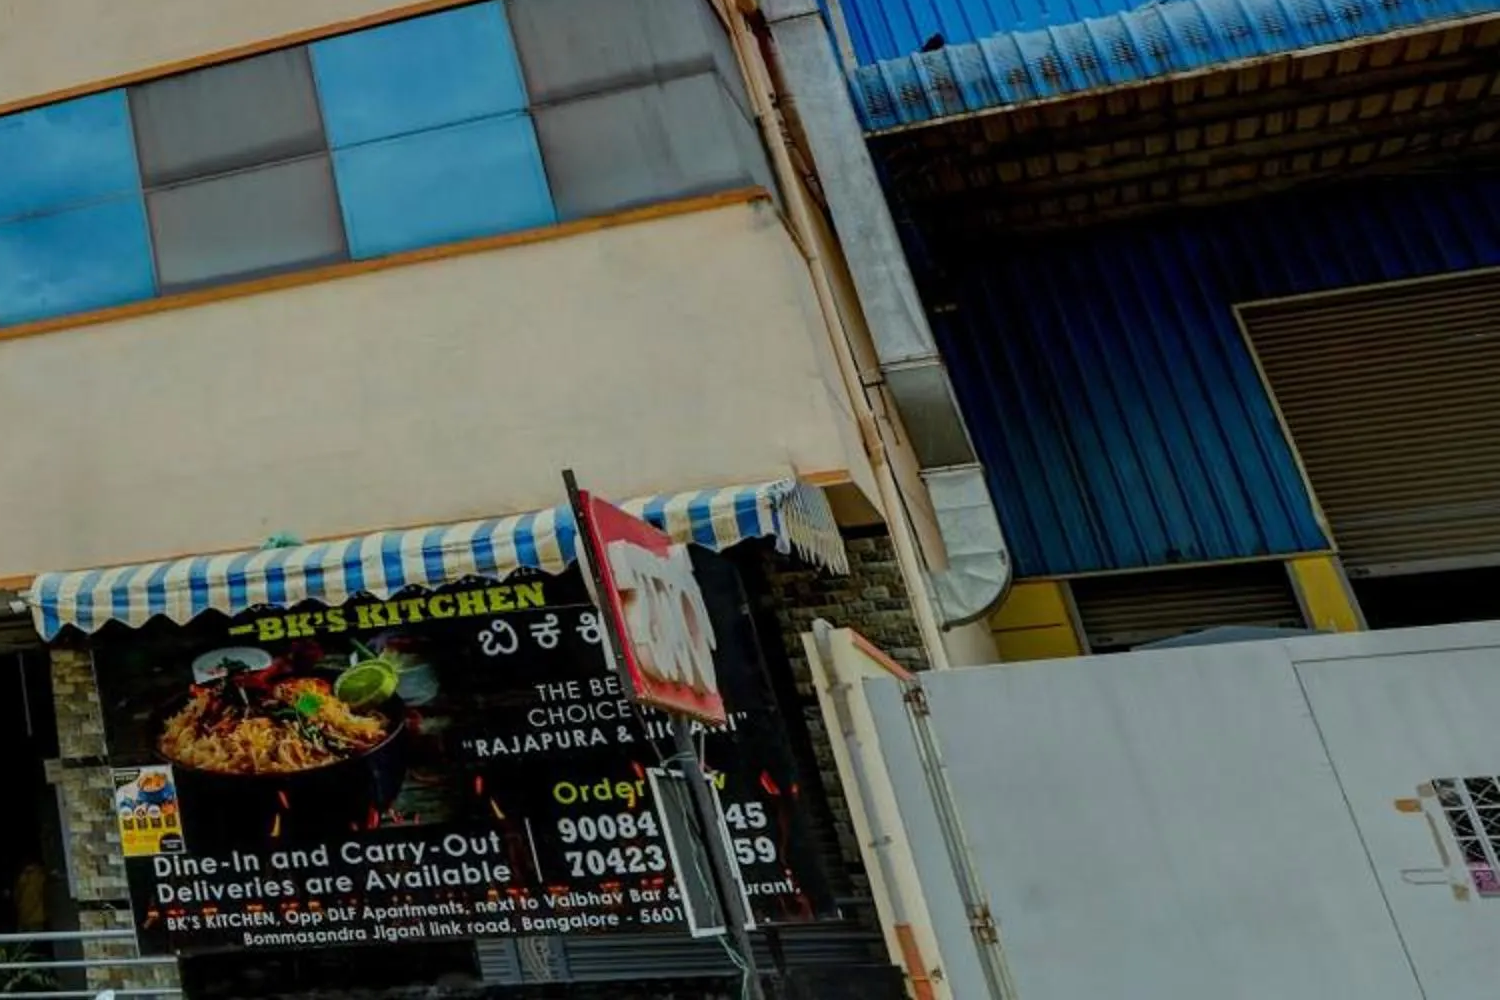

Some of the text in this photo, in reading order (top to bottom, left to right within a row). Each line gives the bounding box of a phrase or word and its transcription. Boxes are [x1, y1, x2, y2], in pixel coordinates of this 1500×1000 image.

[355, 582, 545, 629] KITCHEN
[535, 676, 622, 702] THE BE
[527, 700, 633, 728] CHOICE
[617, 725, 635, 743] &
[553, 777, 646, 805] Order
[153, 830, 500, 877] Dine-In and Carry-Out
[157, 861, 511, 903] Deliveries are Available
[167, 915, 201, 932] BK'S
[285, 909, 323, 927] Opp
[328, 907, 357, 921] DLF
[475, 899, 515, 913] next
[520, 895, 539, 910] to
[544, 890, 624, 909] Vaibhav
[629, 887, 662, 902] Bar
[243, 928, 367, 946] Bommasandra
[372, 923, 425, 942] Jigani
[429, 921, 461, 936] link
[522, 913, 619, 933] Bangalore
